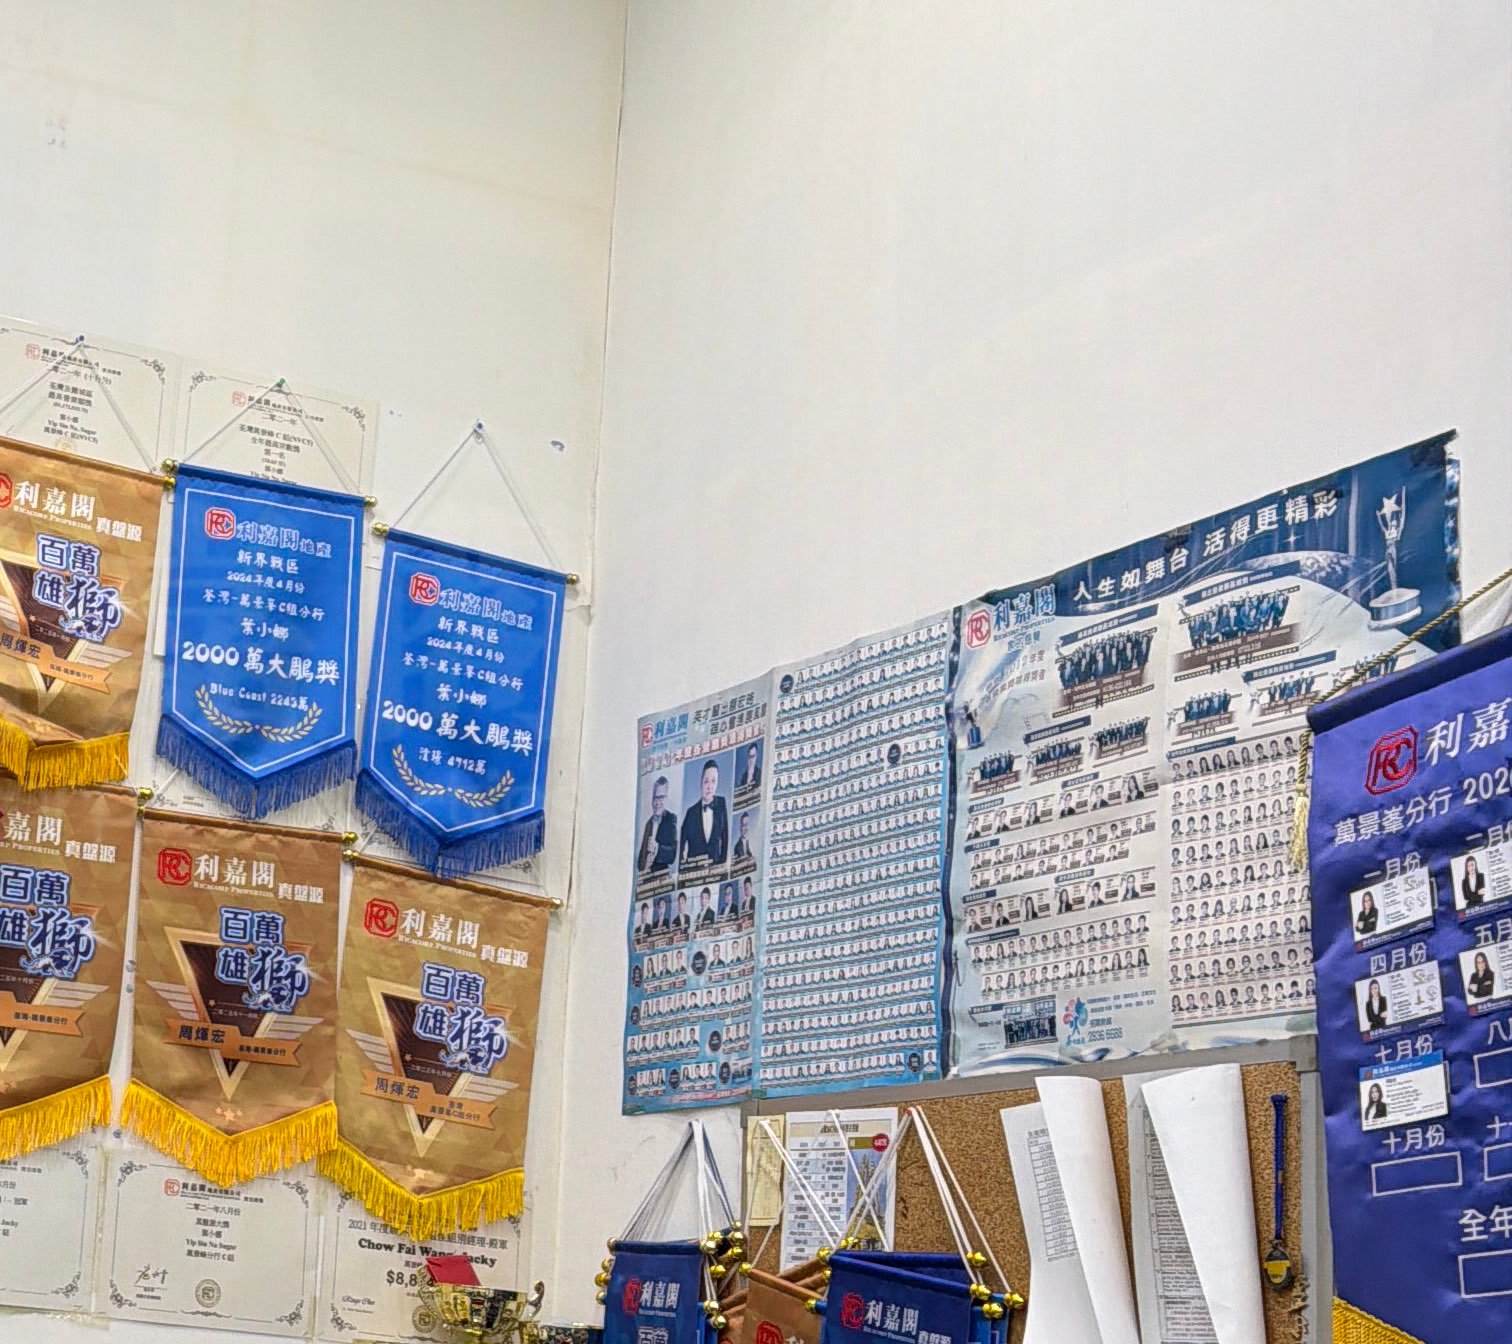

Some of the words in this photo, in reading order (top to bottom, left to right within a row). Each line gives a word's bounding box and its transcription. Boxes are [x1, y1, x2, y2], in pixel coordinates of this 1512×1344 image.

[14, 480, 96, 522] 利嘉閣
[96, 517, 143, 542] 真盤源
[236, 521, 332, 558] 利嘉閣地產
[38, 534, 100, 576] 百萬
[1072, 546, 1189, 603] 人生如舞台
[1203, 489, 1337, 557] 活得更精彩
[237, 550, 299, 574] 新界戰區
[227, 571, 305, 594] 2024年度4月份
[439, 588, 532, 630] 利嘉閣地產
[993, 583, 1056, 630] 利嘉閣
[438, 616, 499, 644] 新界戰區
[182, 641, 239, 667] 2000
[210, 682, 233, 696] Blue
[239, 687, 266, 703] Coast
[382, 701, 433, 730] 2000
[1334, 786, 1452, 846] 萬景峯分行
[1462, 767, 1512, 805] 202
[4, 810, 63, 846] 嘉閣
[65, 840, 117, 863] 真盤源
[194, 854, 275, 889] 利嘉閣
[278, 882, 324, 904] 真盤源
[220, 908, 284, 945] 百萬
[400, 908, 480, 950] 利嘉閣
[481, 945, 529, 968] 真盤源
[1369, 942, 1427, 976] 四月份
[422, 963, 484, 1007] 百萬
[1383, 1124, 1445, 1154] 十月份
[1, 1219, 18, 1228] Jacky
[348, 1219, 367, 1230] 2021
[358, 1238, 395, 1251] Chow
[397, 1243, 416, 1255] Fai
[640, 1281, 680, 1309] 利嘉閣
[865, 1300, 919, 1335] 利嘉閣
